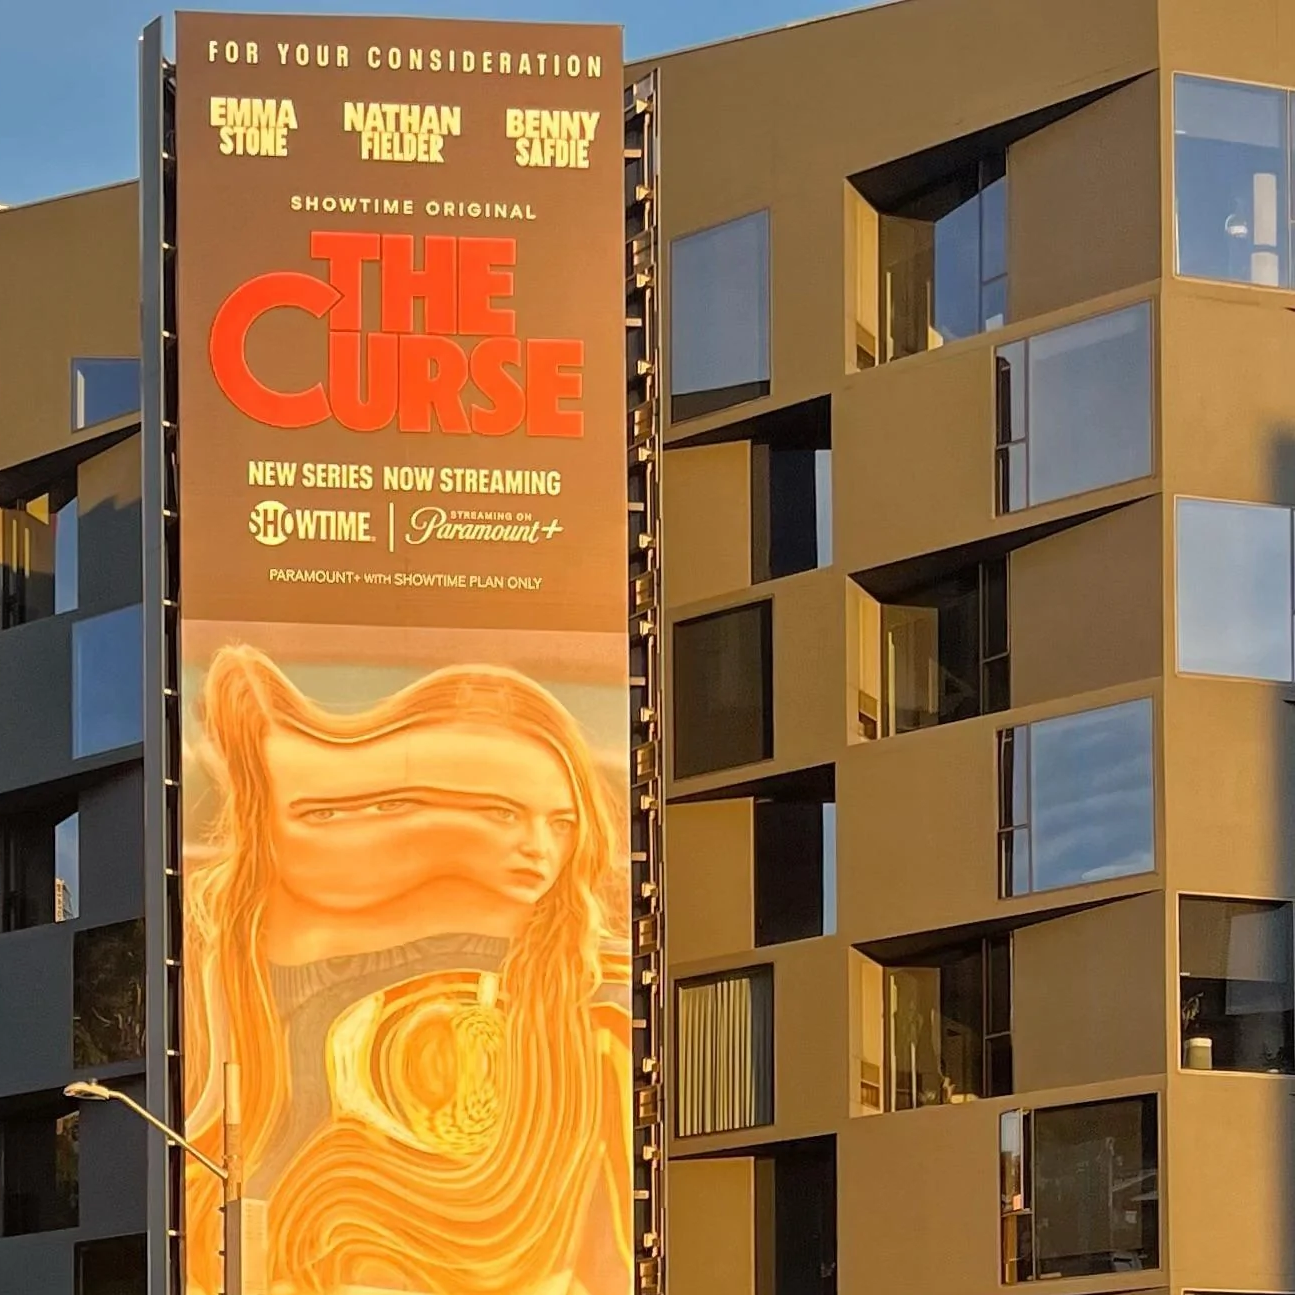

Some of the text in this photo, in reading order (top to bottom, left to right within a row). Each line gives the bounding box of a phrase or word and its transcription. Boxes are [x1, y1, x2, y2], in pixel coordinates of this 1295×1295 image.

[209, 40, 602, 78] FOR YOUR CONSIDERATION
[210, 97, 298, 129] EMMA
[344, 102, 461, 136] NATHAN
[506, 109, 600, 141] BENNY
[219, 126, 288, 157] STONE
[361, 131, 445, 163] FIELDER
[515, 138, 589, 168] SAFDIE
[290, 195, 537, 220] SHOWTIME ORIGINAL
[311, 231, 516, 335] THE
[210, 272, 584, 437] CURSE
[248, 460, 561, 496] NEW SERIES NOW STREAMING
[248, 500, 372, 546] SHOWTIME
[450, 510, 532, 522] STREAMING ON
[269, 568, 543, 590] PARAMOUNT+ WITH SHOWTIME PLAN ONLY
